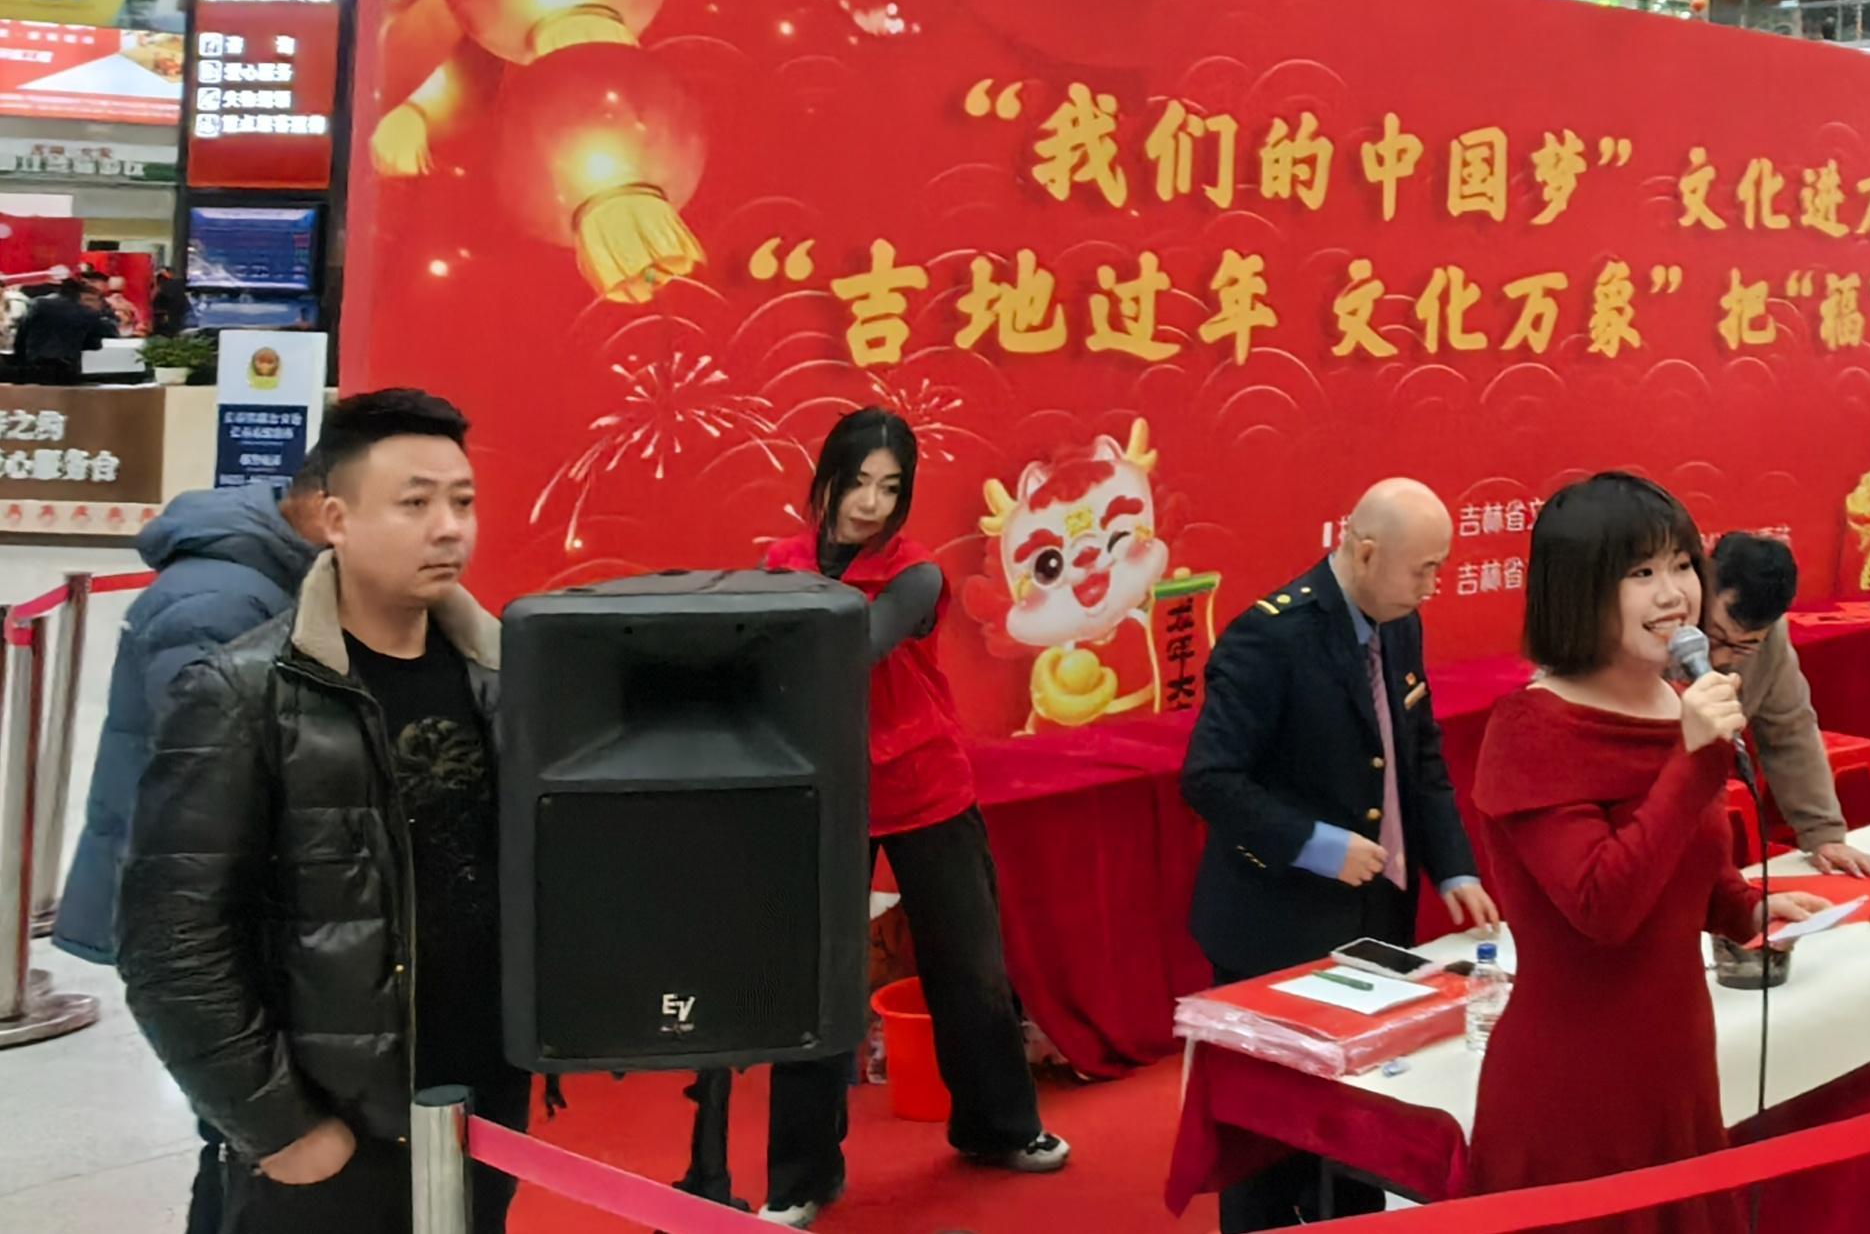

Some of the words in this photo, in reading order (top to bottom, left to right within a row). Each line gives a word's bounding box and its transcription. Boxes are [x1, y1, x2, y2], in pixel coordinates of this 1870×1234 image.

[963, 78, 1633, 226] “我们的中国梦”
[749, 237, 1278, 366] “吉地过年
[1331, 259, 1683, 358] 文化万象”
[0, 448, 120, 482] 心服务台
